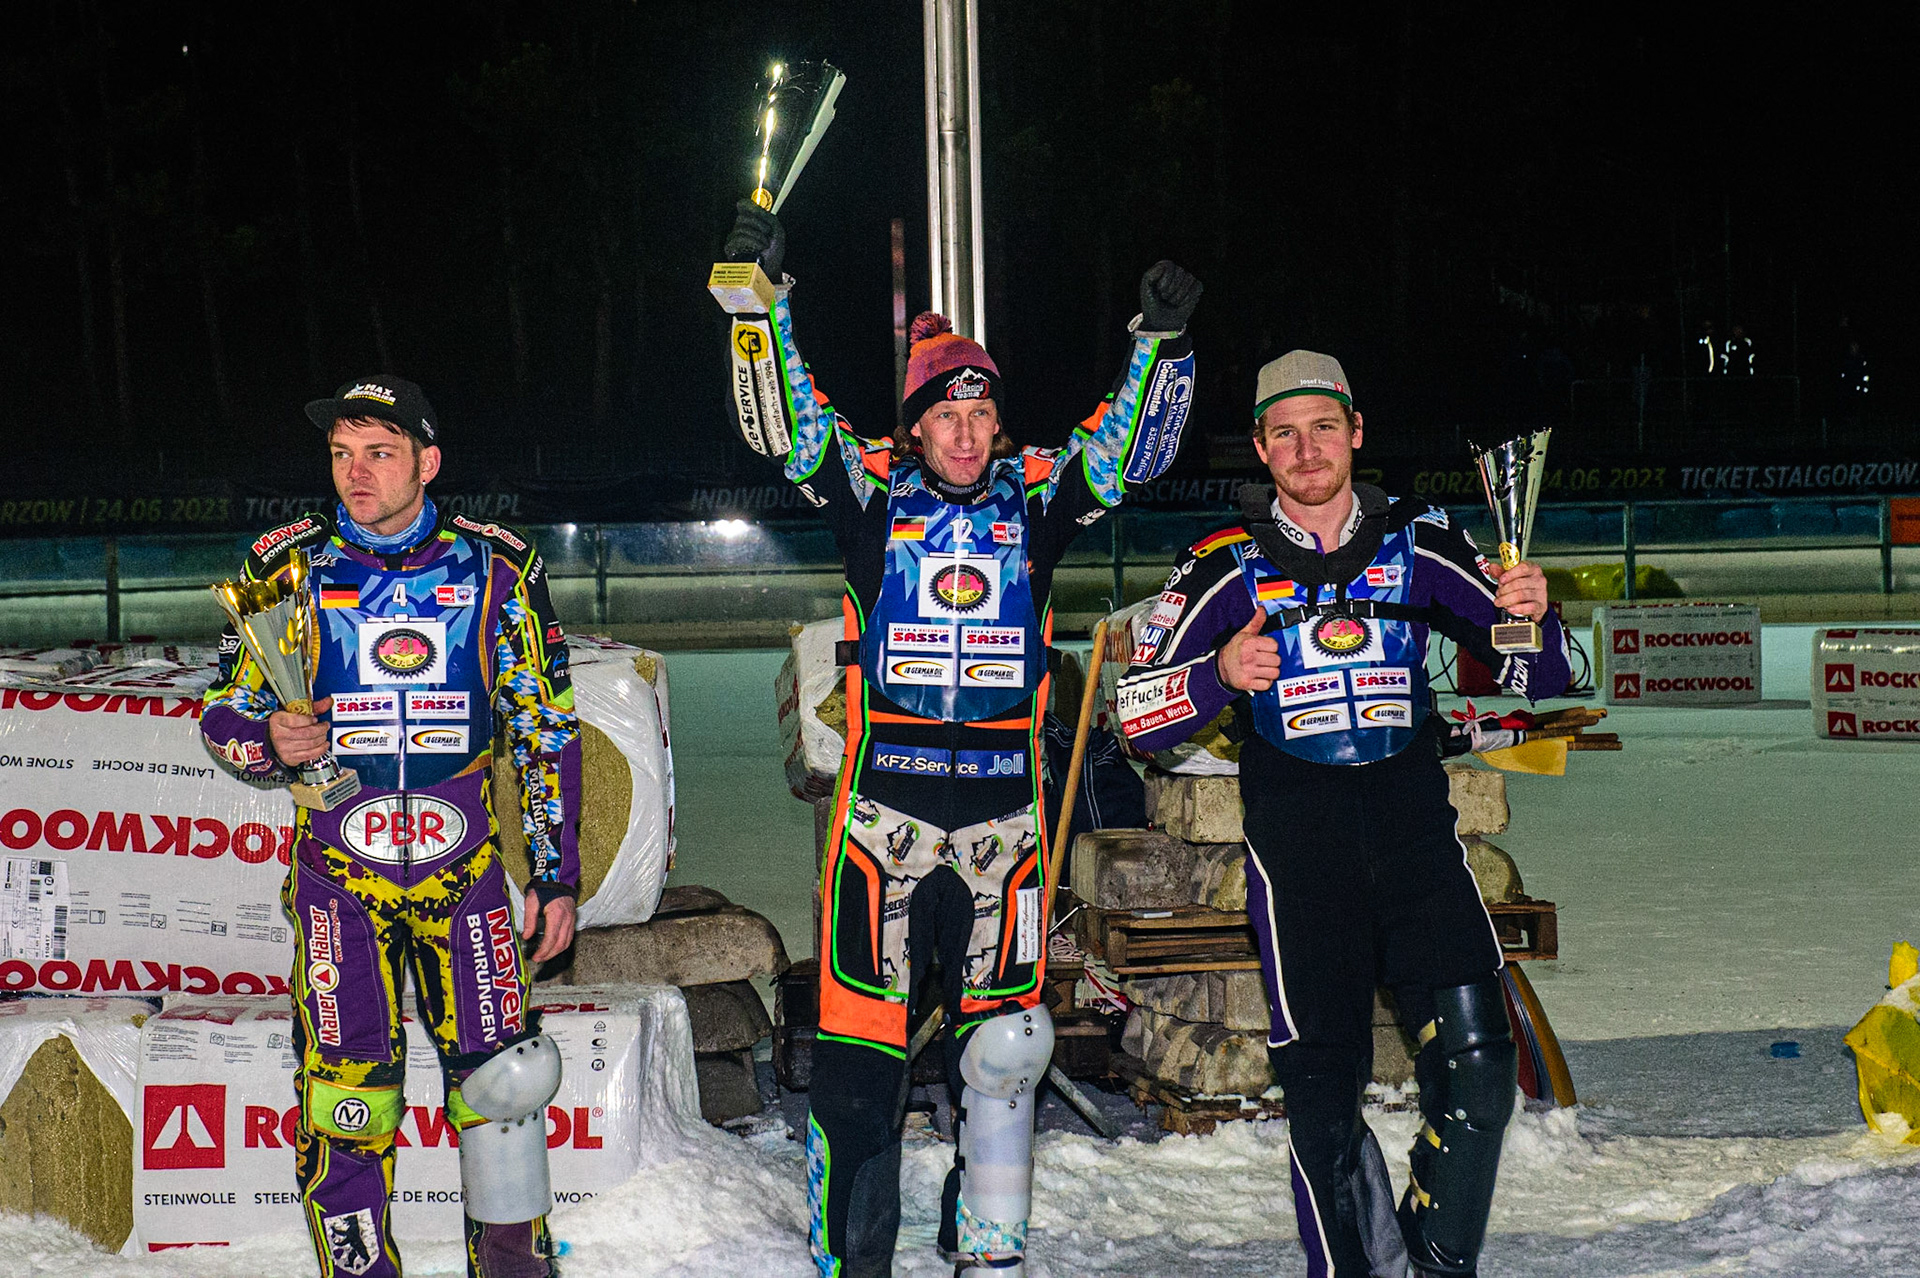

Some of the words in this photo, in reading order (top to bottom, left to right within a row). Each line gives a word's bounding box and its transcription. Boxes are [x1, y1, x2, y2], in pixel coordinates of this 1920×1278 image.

[765, 360, 776, 380] 1996
[364, 383, 393, 397] MAX
[1147, 361, 1173, 418] Continentale
[453, 515, 483, 531] Mauer
[497, 528, 527, 552] Häuser
[949, 518, 974, 543] 12
[1273, 512, 1304, 543] WACO
[252, 518, 314, 557] Mayer
[261, 524, 322, 564] BOHRUNGEN
[392, 583, 408, 608] 4
[1159, 592, 1187, 607] EER
[893, 632, 949, 644] SASSE
[966, 634, 1020, 645] SASSE
[1644, 631, 1753, 648] ROCKWOOL
[1356, 676, 1407, 687] SASSE
[1645, 677, 1754, 693] ROCKWOOL
[1860, 670, 1920, 688] ROCK
[1283, 680, 1339, 698] SASSE
[337, 701, 393, 712] SASSE
[411, 700, 465, 710] SASSE
[1140, 712, 1167, 731] Bauen.
[1165, 703, 1192, 719] Werte.
[1862, 719, 1920, 734] ROCK
[0, 755, 23, 766] WO
[27, 757, 75, 770] STONE
[92, 759, 145, 772] ROCHE
[148, 762, 167, 775] DE
[875, 753, 979, 776] KFZ-Service
[987, 752, 1024, 776] Jell
[171, 766, 215, 780] LAINE
[364, 810, 447, 847] PBR
[309, 905, 331, 962] Häuser
[466, 913, 497, 1043] BOHRUNGEN
[486, 906, 522, 1035] Mayer
[316, 991, 342, 1046] Mauer
[144, 1192, 237, 1206] STEINWOLLE
[254, 1192, 301, 1205] STEEN
[403, 1191, 423, 1203] DE
[427, 1191, 465, 1203] ROC
